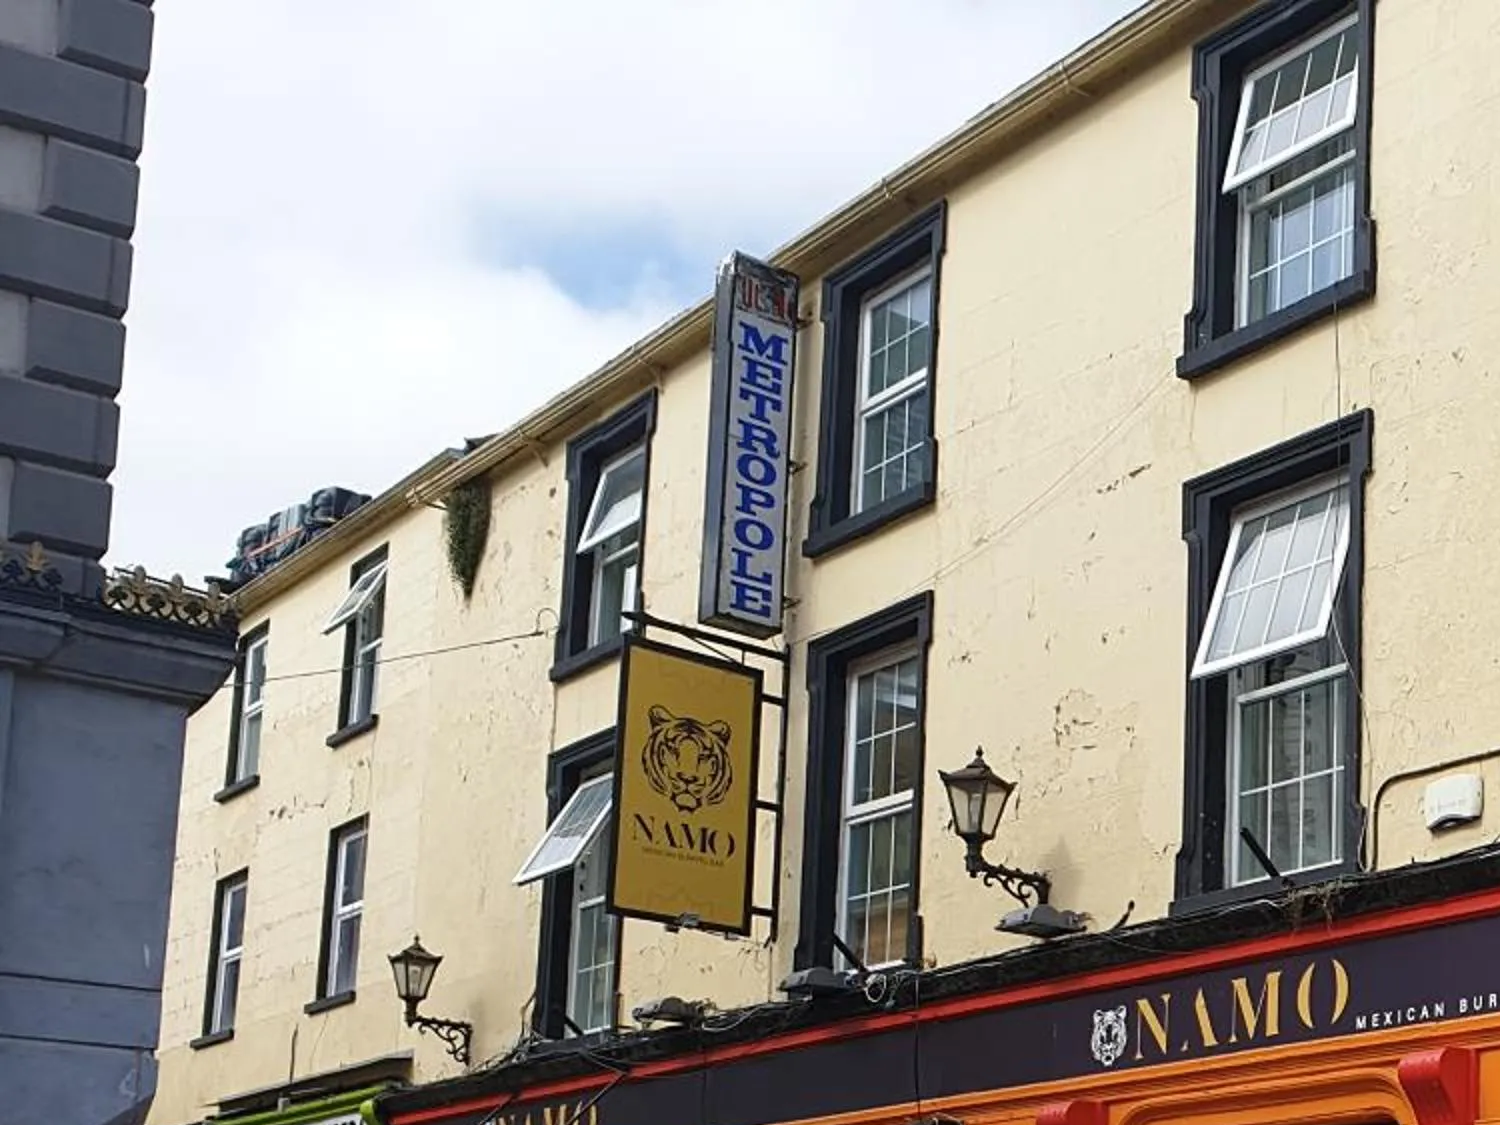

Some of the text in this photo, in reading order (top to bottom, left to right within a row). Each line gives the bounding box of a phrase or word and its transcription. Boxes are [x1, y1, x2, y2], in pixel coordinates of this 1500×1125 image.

[730, 319, 789, 618] METROPOLE
[633, 813, 736, 858] NAMO
[1135, 959, 1350, 1060] NAMO
[1355, 1001, 1446, 1031] MEXICAN
